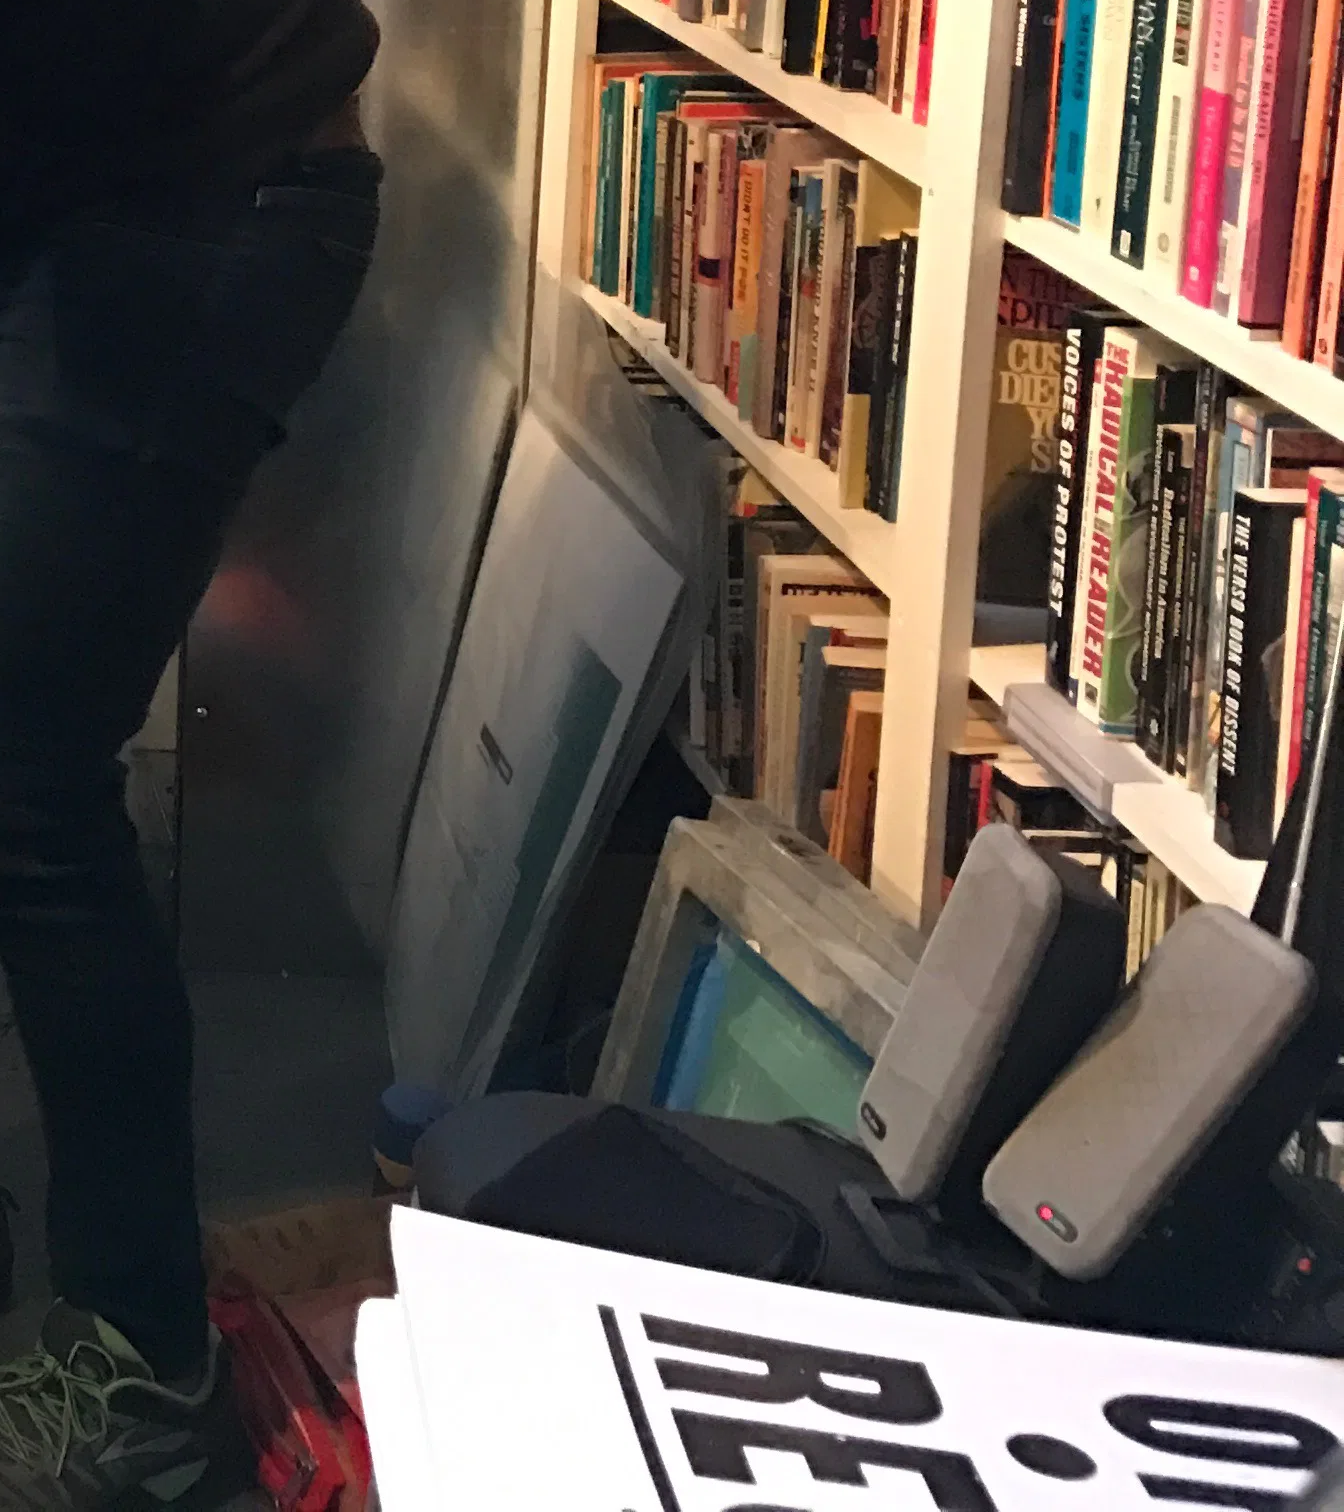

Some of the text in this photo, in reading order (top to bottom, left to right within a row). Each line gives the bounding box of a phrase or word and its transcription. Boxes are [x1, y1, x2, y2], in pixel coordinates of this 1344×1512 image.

[1015, 8, 1027, 67] Women
[1049, 328, 1082, 618] VOICES OF PROTEST
[1094, 358, 1129, 520] RADICAL
[1083, 531, 1112, 679] READER
[1221, 514, 1251, 777] THE VERSO BOOK OF DISSENT
